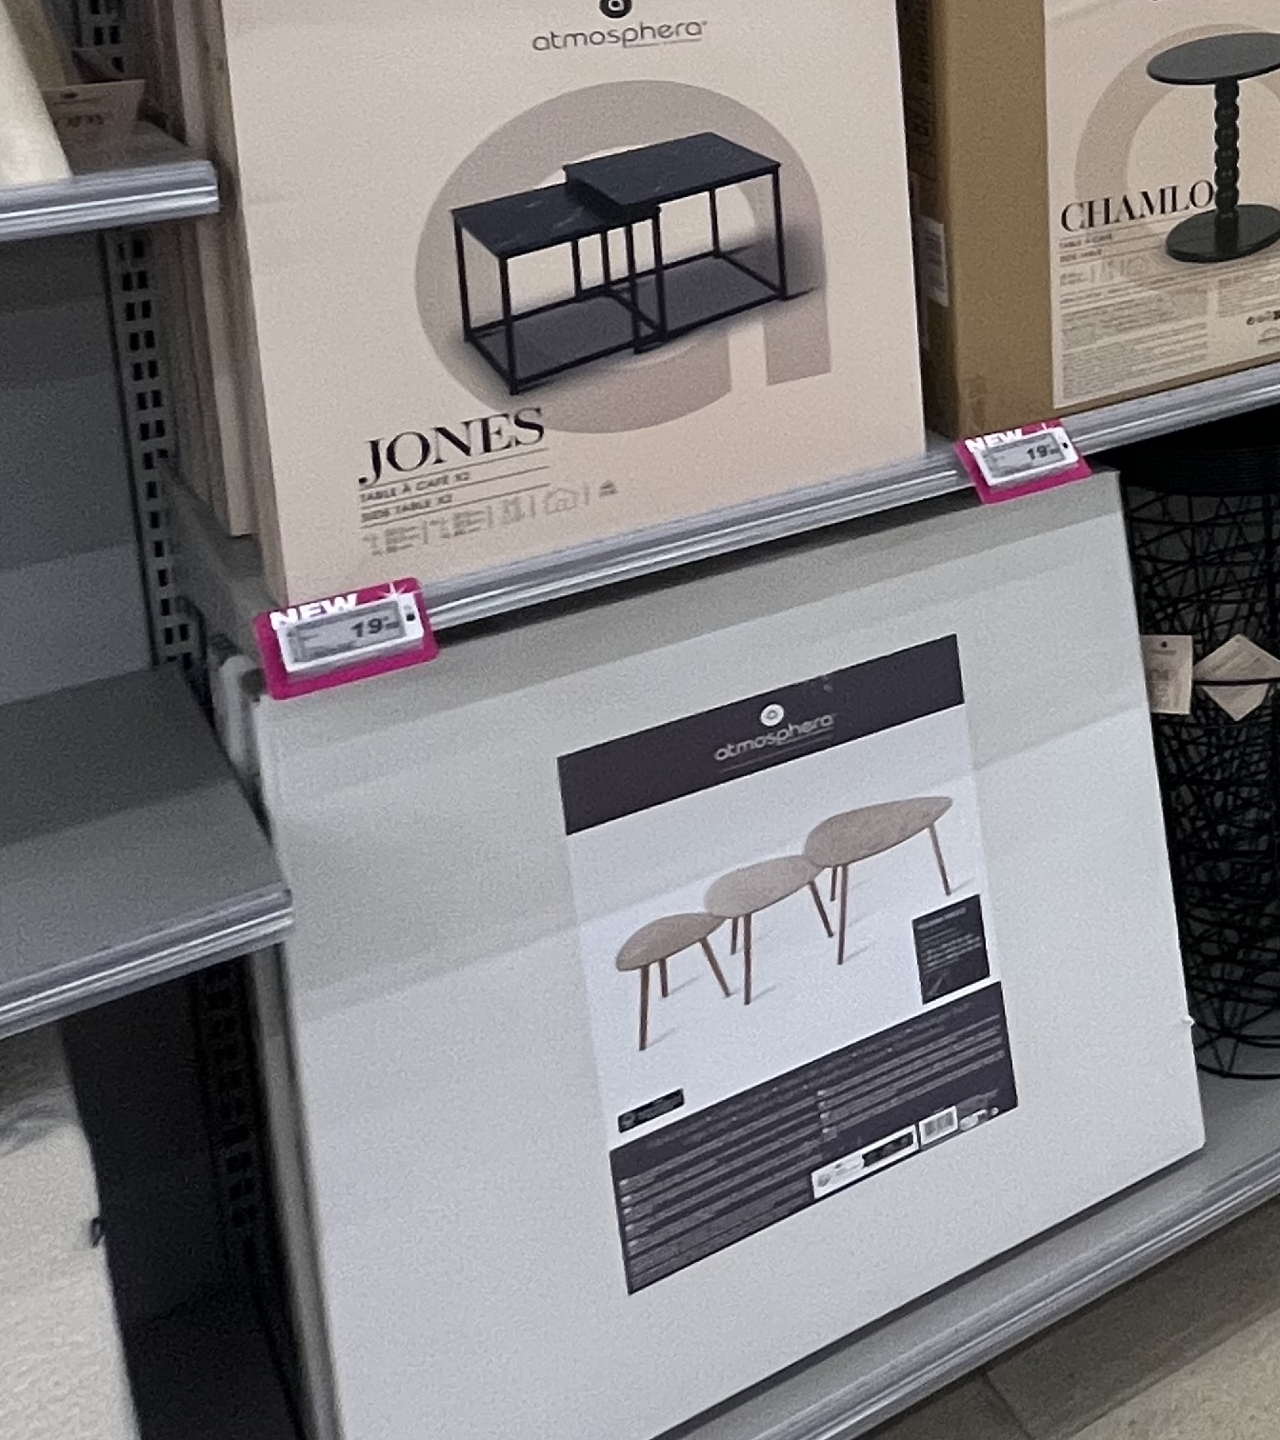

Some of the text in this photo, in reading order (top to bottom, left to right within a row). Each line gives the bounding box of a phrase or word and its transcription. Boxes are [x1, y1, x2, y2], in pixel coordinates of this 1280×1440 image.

[532, 20, 707, 52] atmosphera
[1060, 179, 1215, 233] CHAMLO
[358, 407, 545, 488] JONES
[964, 428, 1023, 454] NEW
[1026, 444, 1048, 461] 19
[269, 592, 359, 631] NEW
[350, 618, 384, 639] 19
[714, 713, 838, 761] atmosphera
